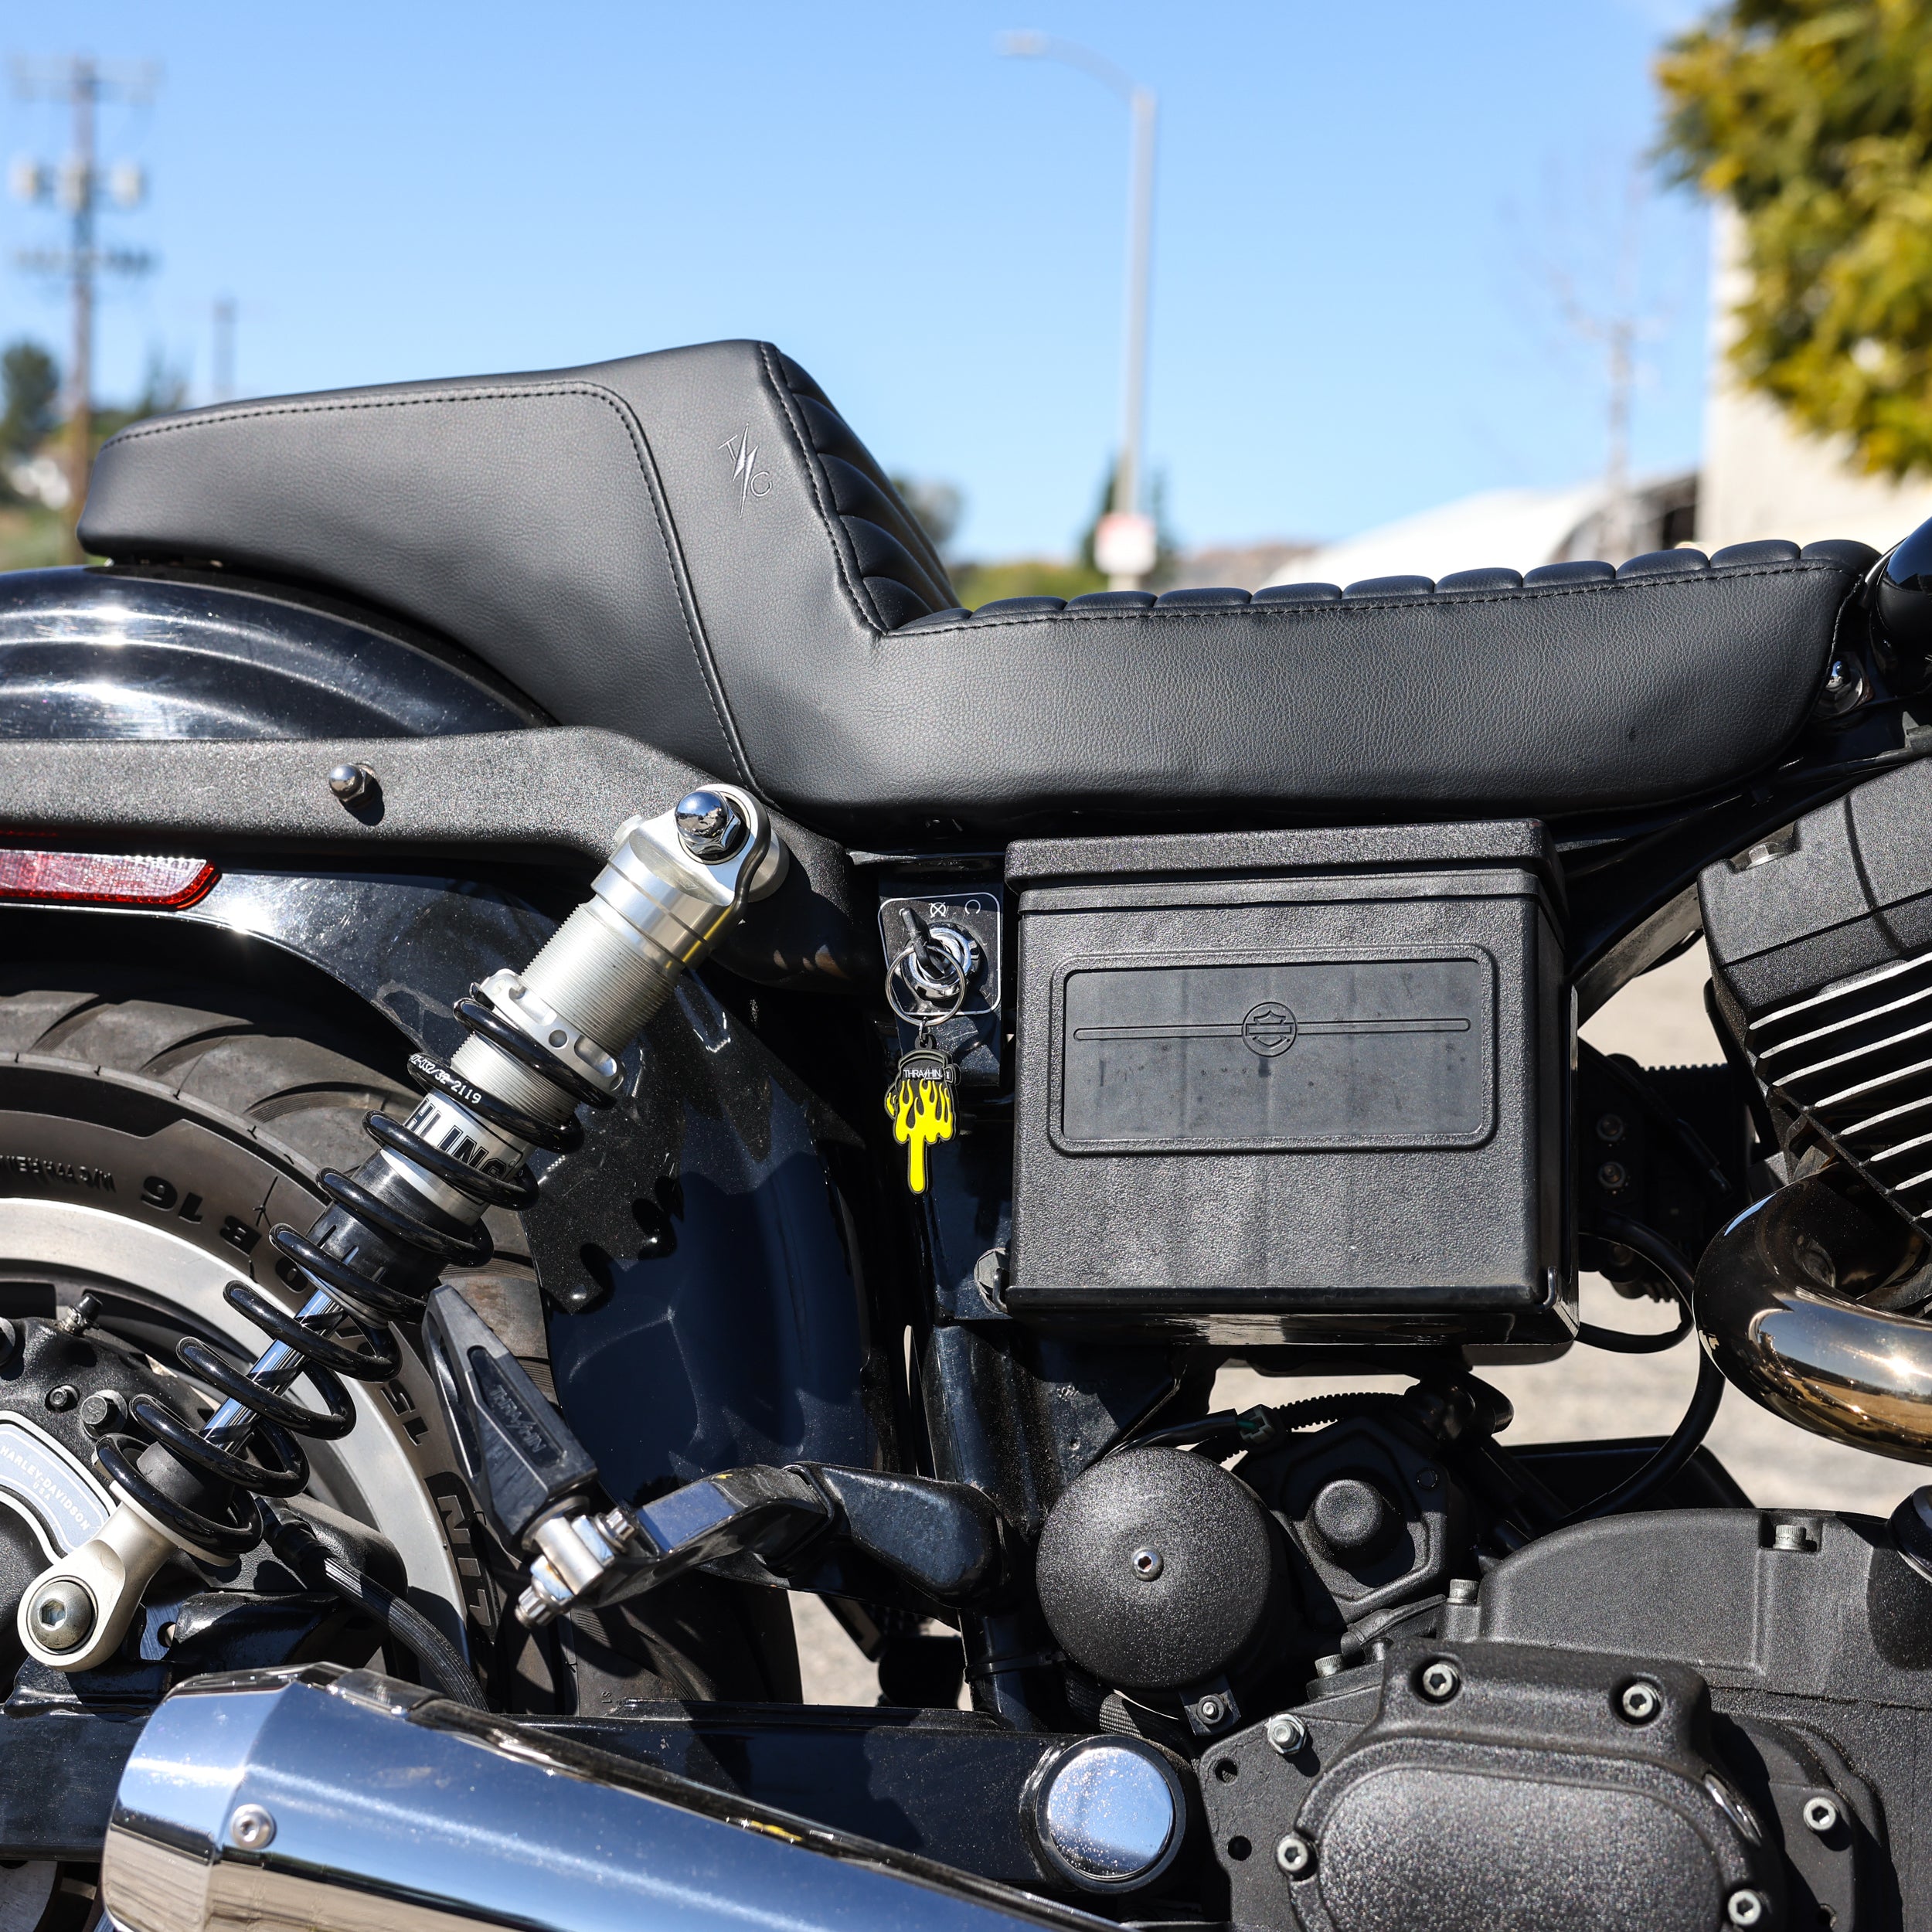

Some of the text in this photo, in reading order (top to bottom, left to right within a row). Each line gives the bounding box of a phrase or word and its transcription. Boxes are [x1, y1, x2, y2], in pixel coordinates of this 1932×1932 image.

[451, 1080, 482, 1104] 2119
[141, 1175, 204, 1225] 16
[0, 1445, 90, 1531] HARLEY-DAVIDSON
